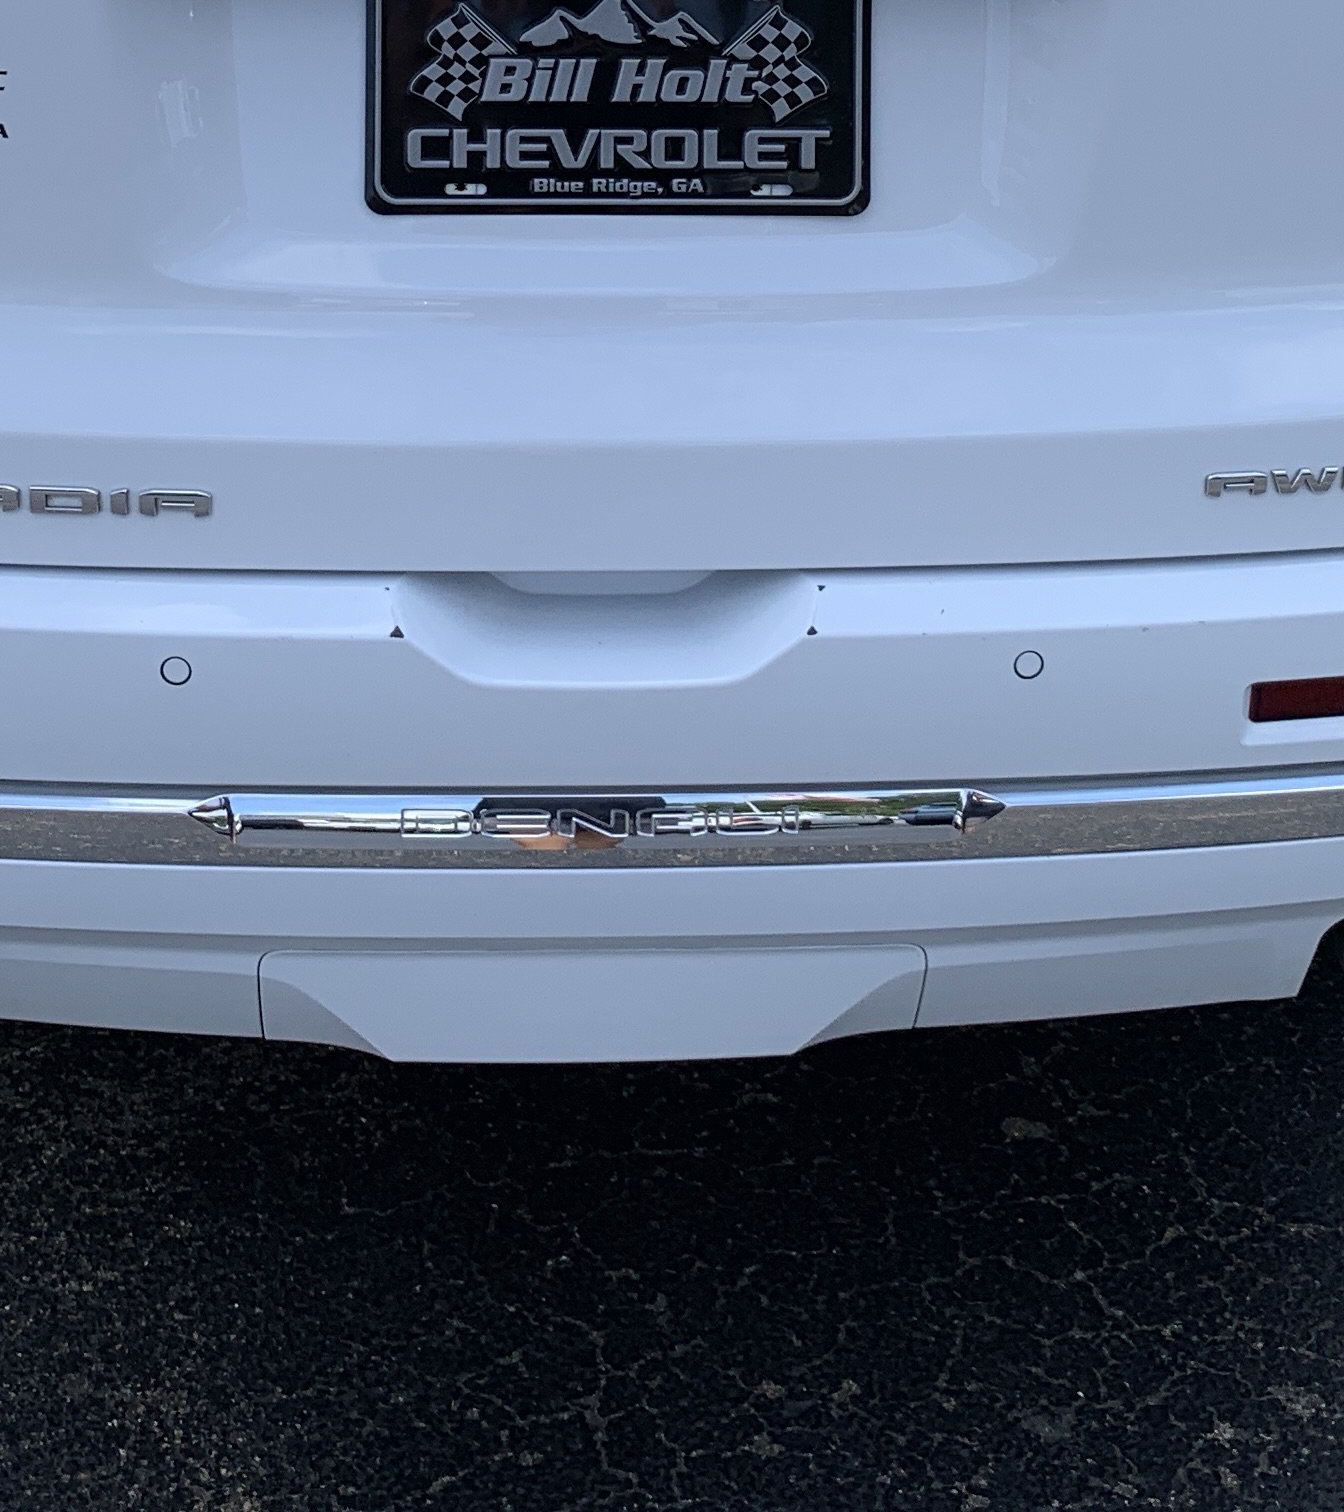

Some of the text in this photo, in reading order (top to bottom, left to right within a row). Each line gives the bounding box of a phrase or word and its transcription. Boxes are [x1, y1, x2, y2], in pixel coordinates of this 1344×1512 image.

[479, 57, 759, 103] Bill Holt
[406, 128, 832, 170] CHEVROLET
[533, 178, 705, 196] Blue Ridge, GA
[400, 805, 800, 838] DENALI
